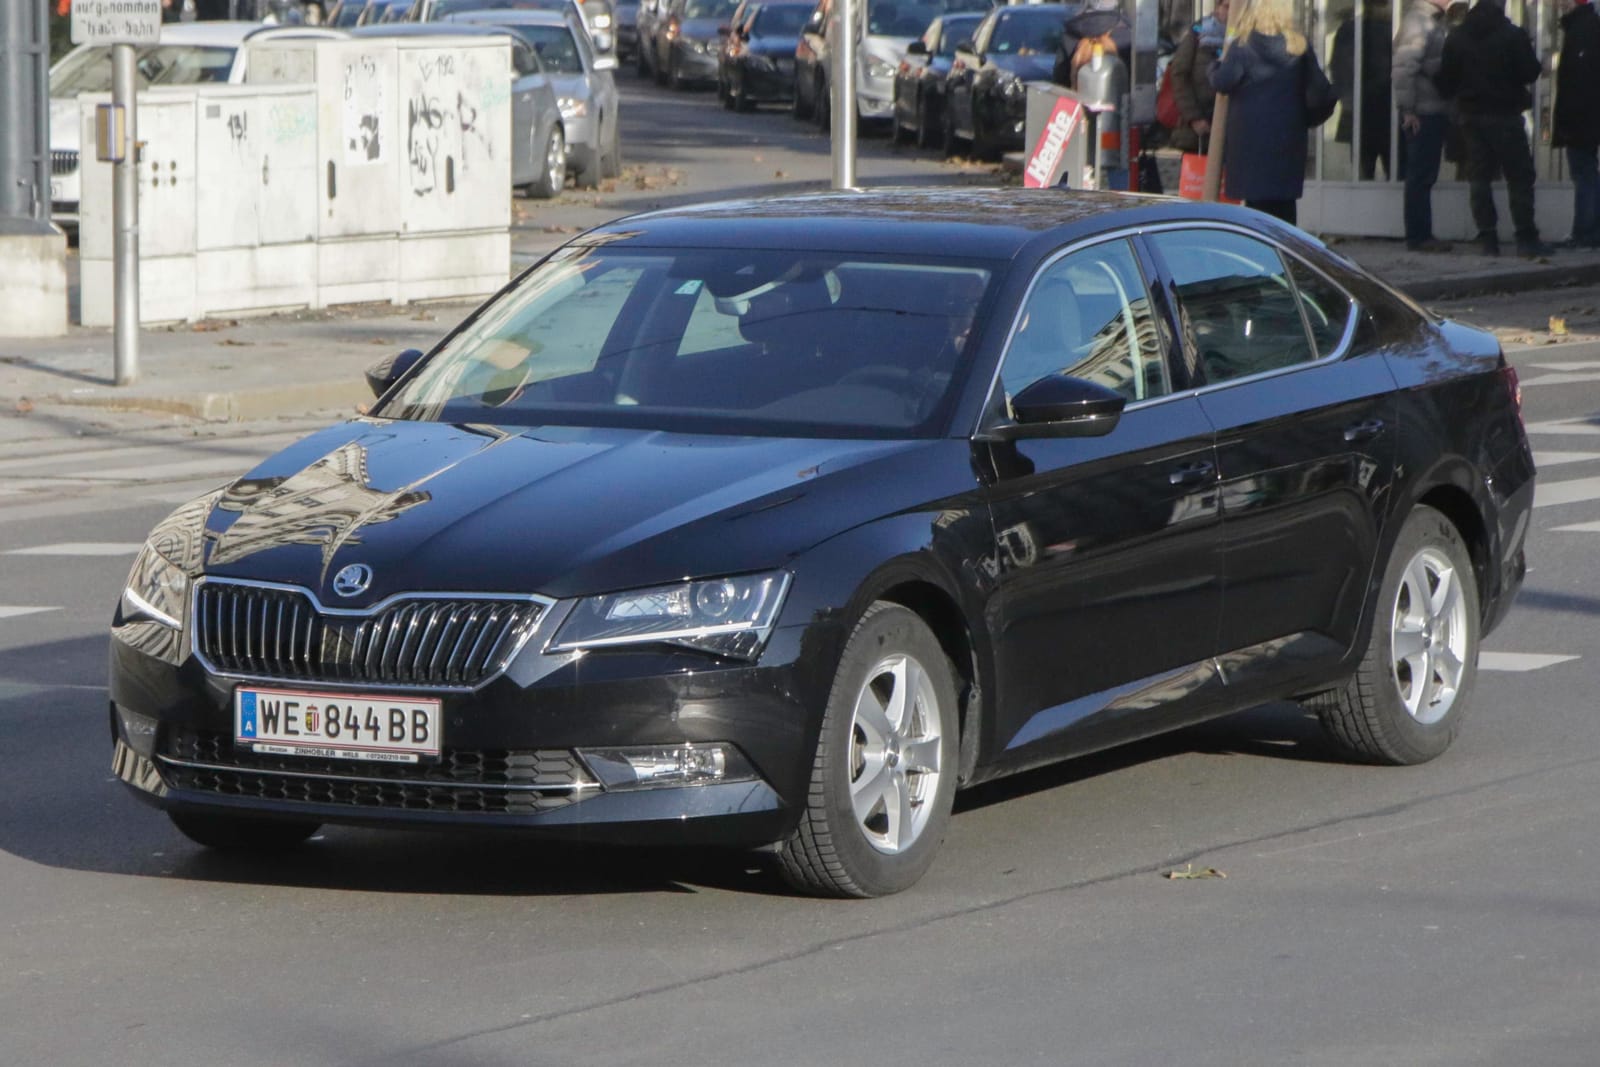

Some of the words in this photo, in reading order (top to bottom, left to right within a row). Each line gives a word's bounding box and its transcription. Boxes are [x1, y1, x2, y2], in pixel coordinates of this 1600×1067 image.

[1027, 110, 1072, 184] Heute
[244, 720, 253, 732] A
[260, 699, 300, 735] WE
[324, 704, 380, 742] 844
[388, 708, 429, 744] BB
